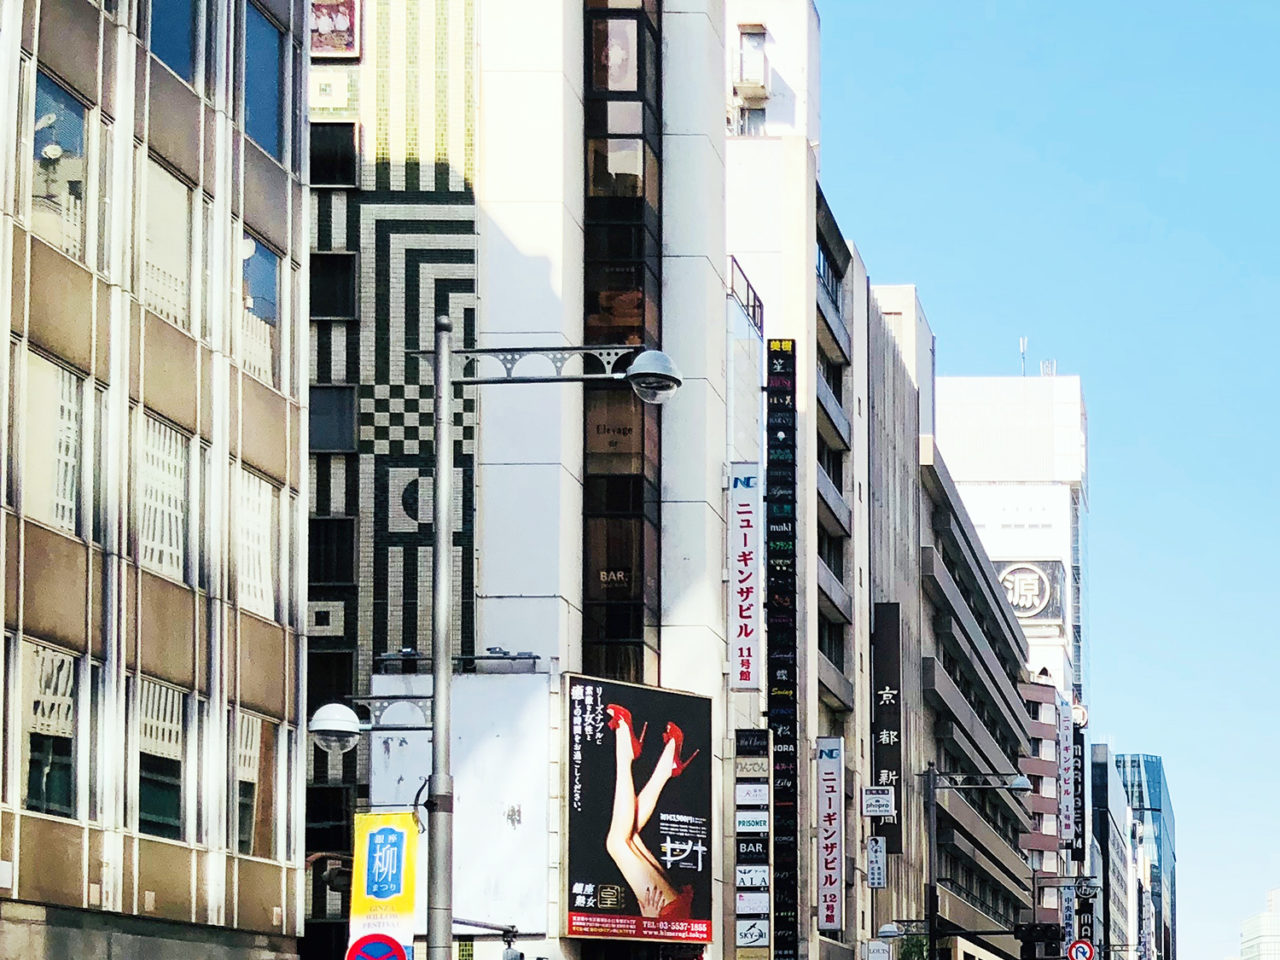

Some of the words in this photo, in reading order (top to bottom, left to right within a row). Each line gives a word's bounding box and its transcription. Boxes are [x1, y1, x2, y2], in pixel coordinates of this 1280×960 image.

[737, 503, 754, 638] ニューギンザビル
[1004, 573, 1041, 609] 源
[737, 647, 753, 682] 11号館
[822, 771, 838, 887] ニューギンザビル
[372, 844, 398, 882] 柳
[822, 893, 838, 924] 12号館
